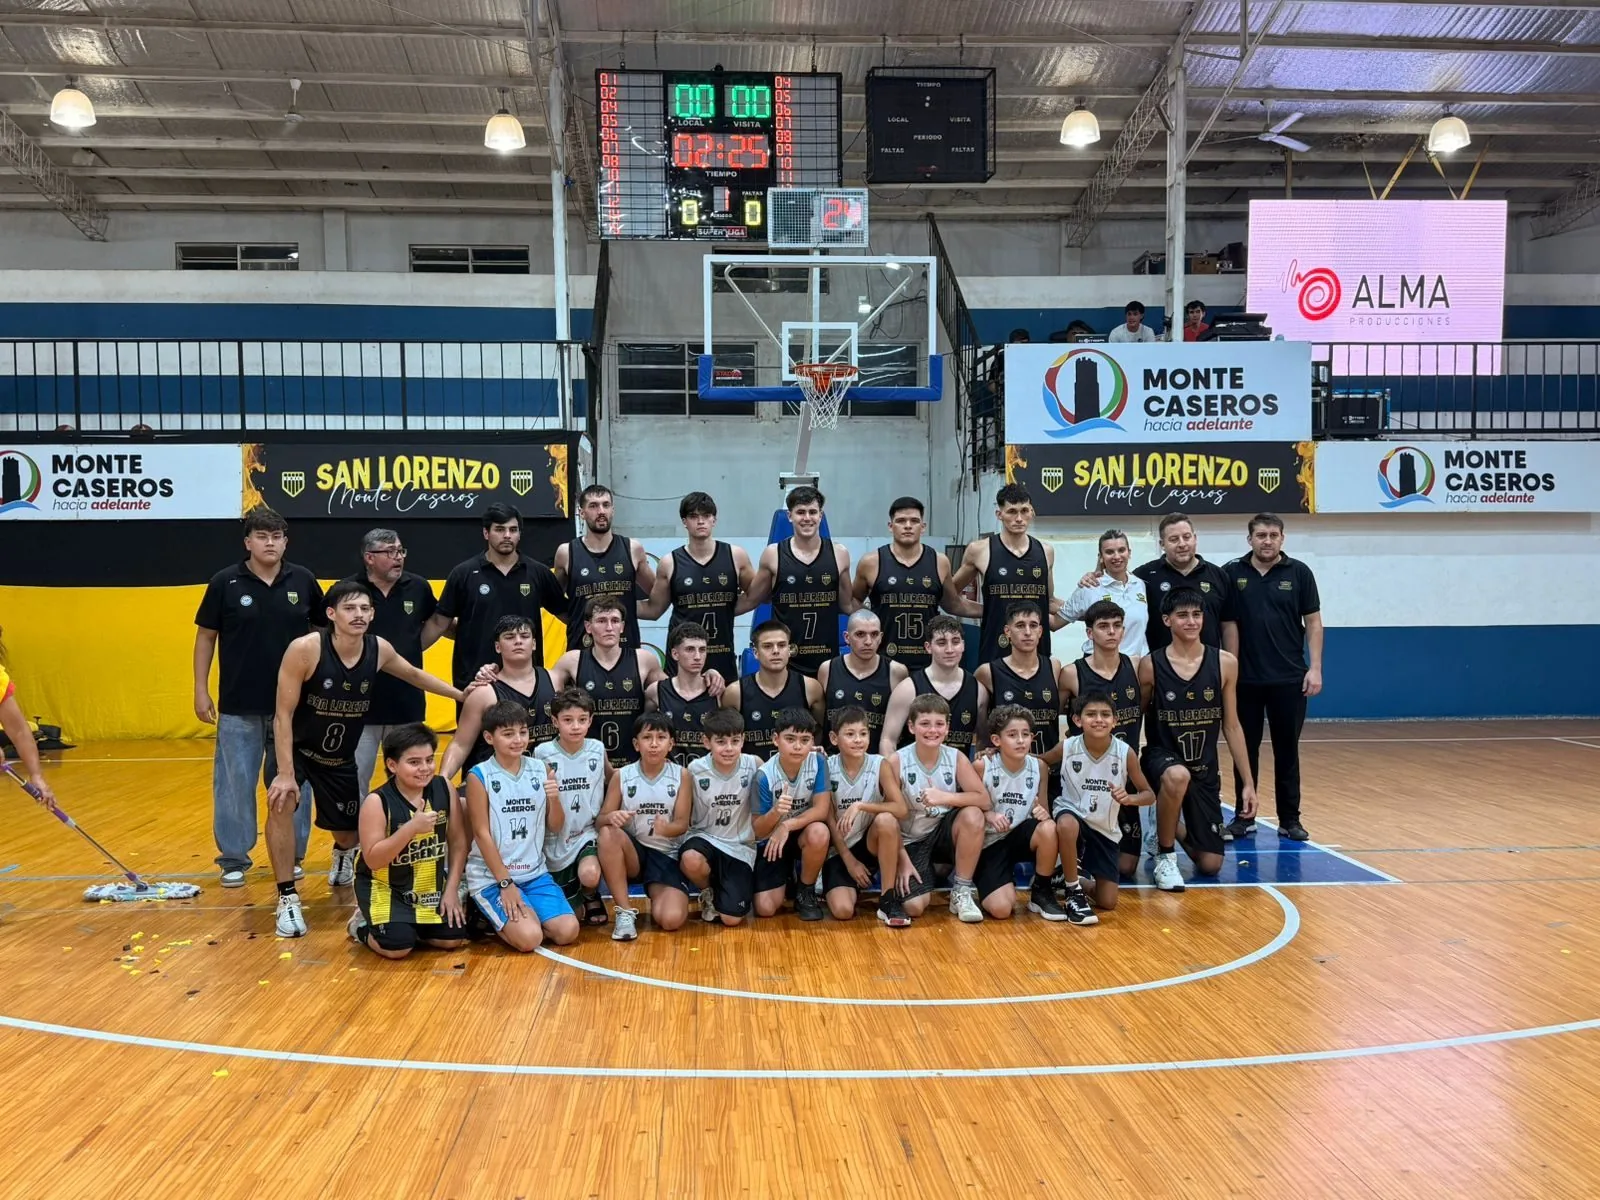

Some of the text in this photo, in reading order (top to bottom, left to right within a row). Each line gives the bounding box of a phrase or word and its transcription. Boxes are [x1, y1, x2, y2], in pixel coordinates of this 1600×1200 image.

[600, 72, 617, 86] 01
[775, 76, 791, 88] 04
[600, 86, 617, 99] 02
[675, 83, 714, 118] 00
[731, 85, 771, 118] 00
[775, 89, 791, 102] 05
[601, 100, 618, 113] 04
[775, 103, 792, 116] 06
[601, 114, 618, 127] 05
[776, 116, 792, 129] 07
[601, 127, 618, 140] 06
[776, 130, 792, 143] 08
[602, 141, 618, 154] 07
[674, 132, 767, 168] 02:25
[602, 154, 619, 168] 08
[780, 157, 792, 170] 10
[682, 199, 699, 225] 0
[745, 200, 761, 225] 0
[1352, 274, 1450, 309] ALMA
[1350, 316, 1450, 326] PRODUCCIONES
[1143, 367, 1245, 391] MONTE
[1143, 393, 1279, 417] CASEROS
[1143, 418, 1254, 431] hacia adelante
[51, 454, 143, 474] MONTE
[1444, 450, 1527, 469] MONTE
[316, 455, 501, 490] SAN LORENZO
[1073, 452, 1249, 488] SAN LORENZO
[52, 478, 174, 498] CASEROS
[1445, 472, 1556, 492] CASEROS
[328, 480, 479, 514] Monte Caseros
[1084, 477, 1227, 510] Monte Caseros
[1445, 492, 1535, 504] hacia adelante
[52, 499, 151, 511] hacia adelante
[701, 611, 718, 639] 4
[802, 611, 818, 640] 7
[894, 612, 924, 640] 15
[321, 722, 346, 752] 8
[600, 720, 620, 752] 6
[1177, 729, 1207, 762] 17
[558, 784, 591, 792] CASEROS
[561, 777, 588, 785] MONTE
[346, 800, 358, 816] 8
[501, 804, 536, 813] CASEROS
[505, 798, 531, 806] MONTE
[570, 793, 581, 814] 4
[710, 799, 741, 808] CASEROS
[509, 816, 529, 840] 14
[408, 833, 439, 853] SAN
[391, 843, 446, 867] LORENZ
